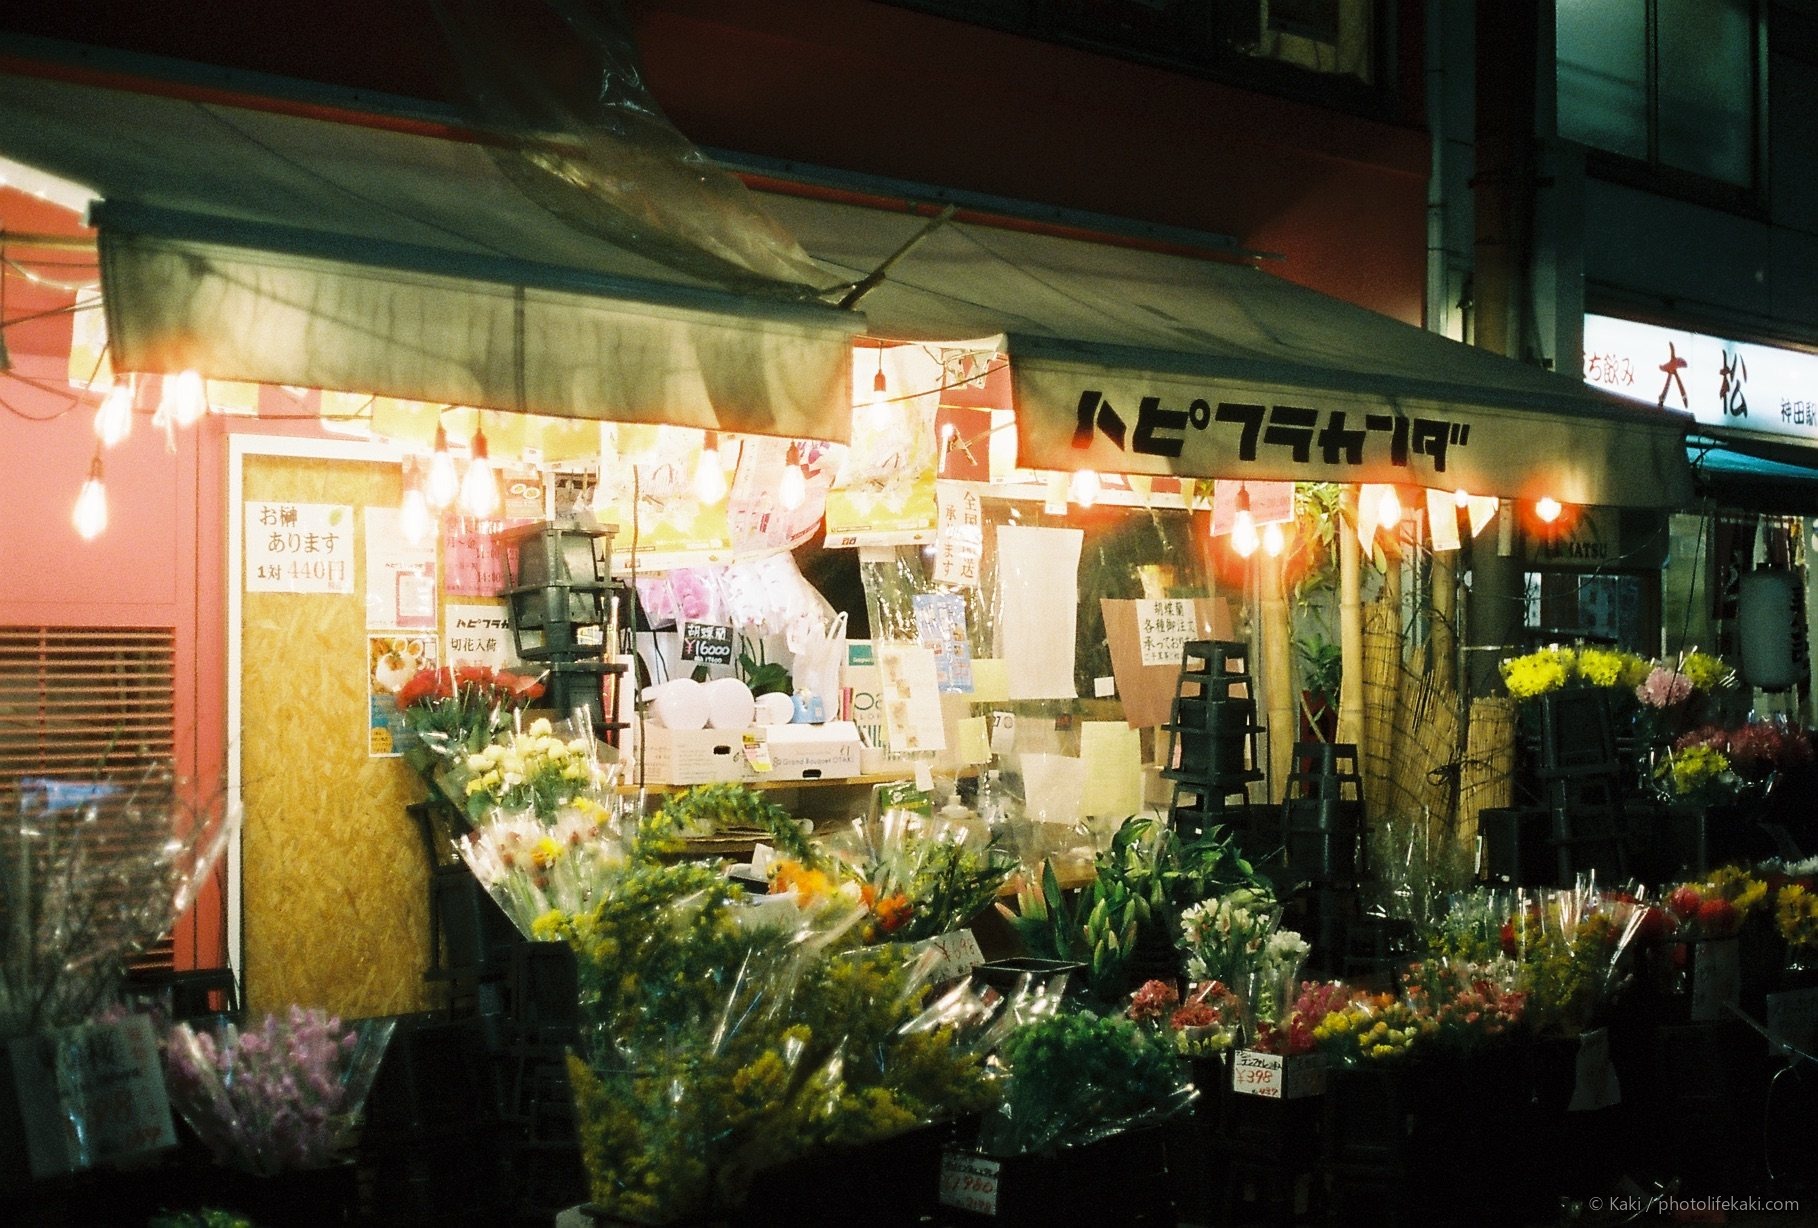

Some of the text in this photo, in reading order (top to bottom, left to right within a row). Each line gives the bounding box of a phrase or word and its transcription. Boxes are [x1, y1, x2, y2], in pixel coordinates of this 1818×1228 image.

[1584, 352, 1634, 386] ち飲み
[268, 532, 340, 554] あります
[258, 560, 345, 581] 1対 440円
[451, 637, 497, 653] 切花入荷
[1235, 1067, 1273, 1085] ¥398
